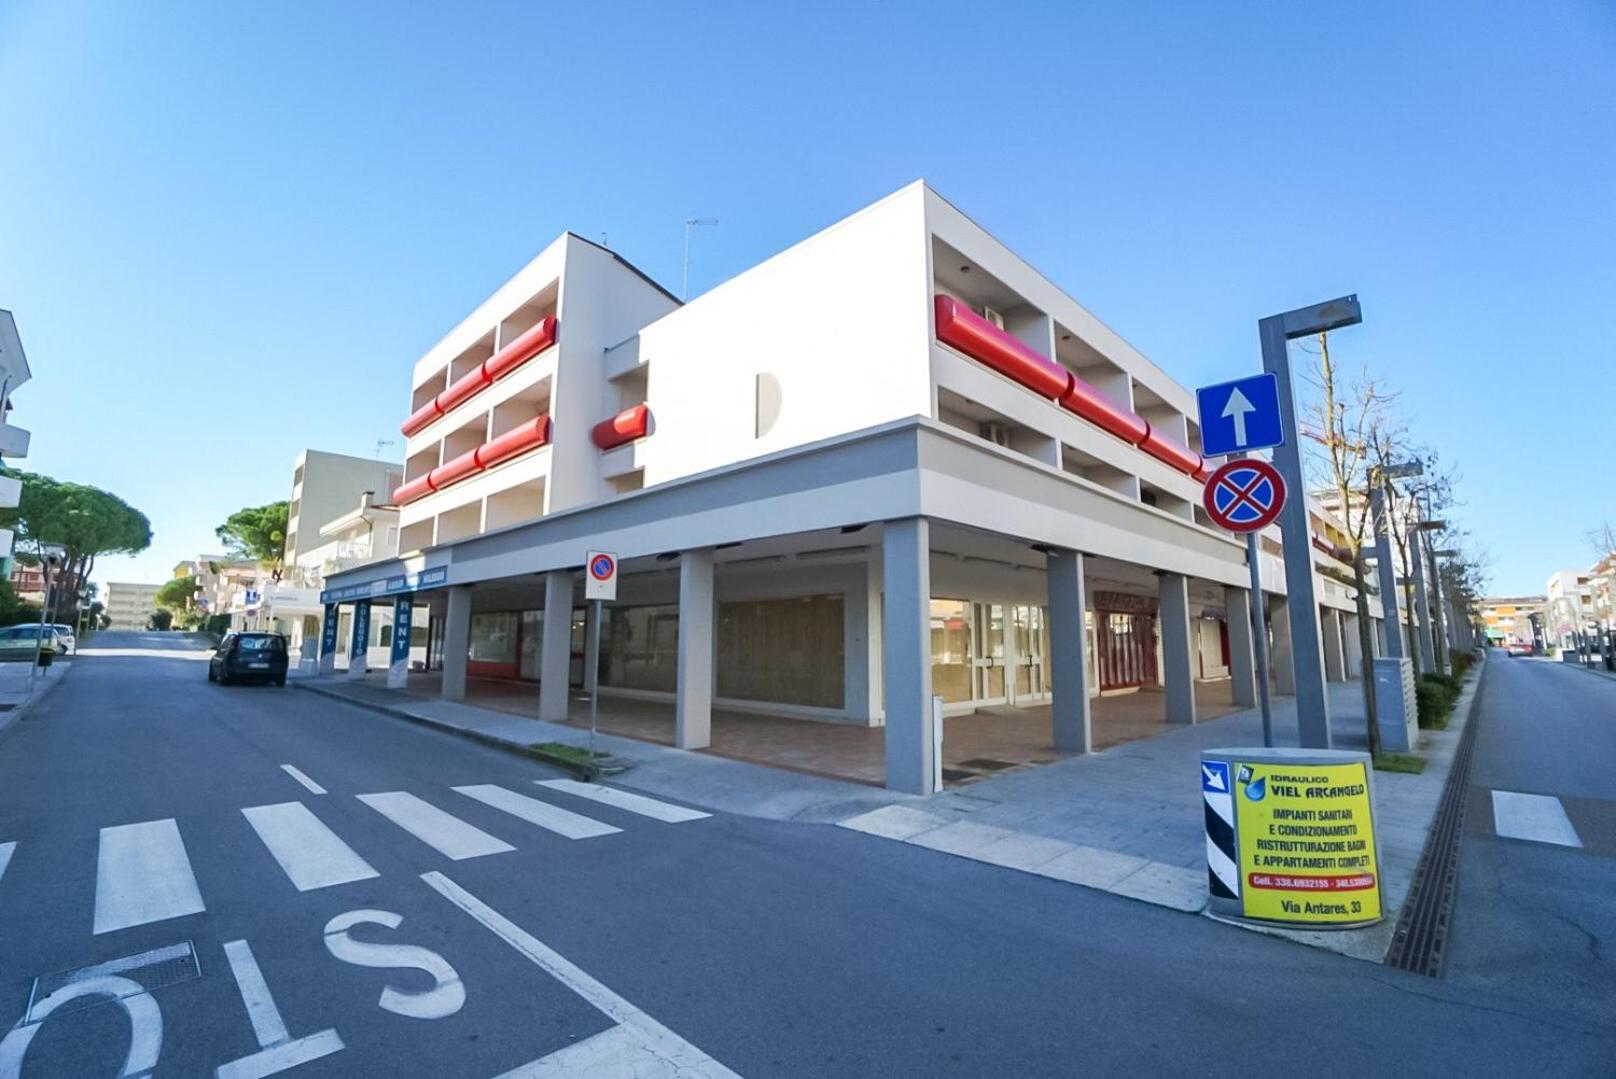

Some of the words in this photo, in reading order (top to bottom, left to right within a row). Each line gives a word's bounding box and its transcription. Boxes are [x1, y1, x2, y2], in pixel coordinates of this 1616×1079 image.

[398, 601, 410, 650] RENT
[1271, 775, 1329, 784] IDRAULICO
[1271, 786, 1302, 797] VIEL
[1306, 784, 1364, 799] ARCANGELO
[1273, 809, 1316, 820] IMPIANTI
[1318, 809, 1352, 821] SANITARI
[1269, 824, 1276, 835] E
[1278, 824, 1358, 837] CONDIZIONAMENTO
[1257, 839, 1345, 852] RISTRUTTURAZIONE
[1347, 840, 1366, 851] BAGNI
[1254, 855, 1260, 866] E
[1263, 855, 1336, 868] APPARTAMENTI
[1338, 855, 1369, 867] COMPLETI
[1282, 901, 1301, 913] Via
[1305, 901, 1349, 915] Antares,
[1351, 901, 1362, 913] 33
